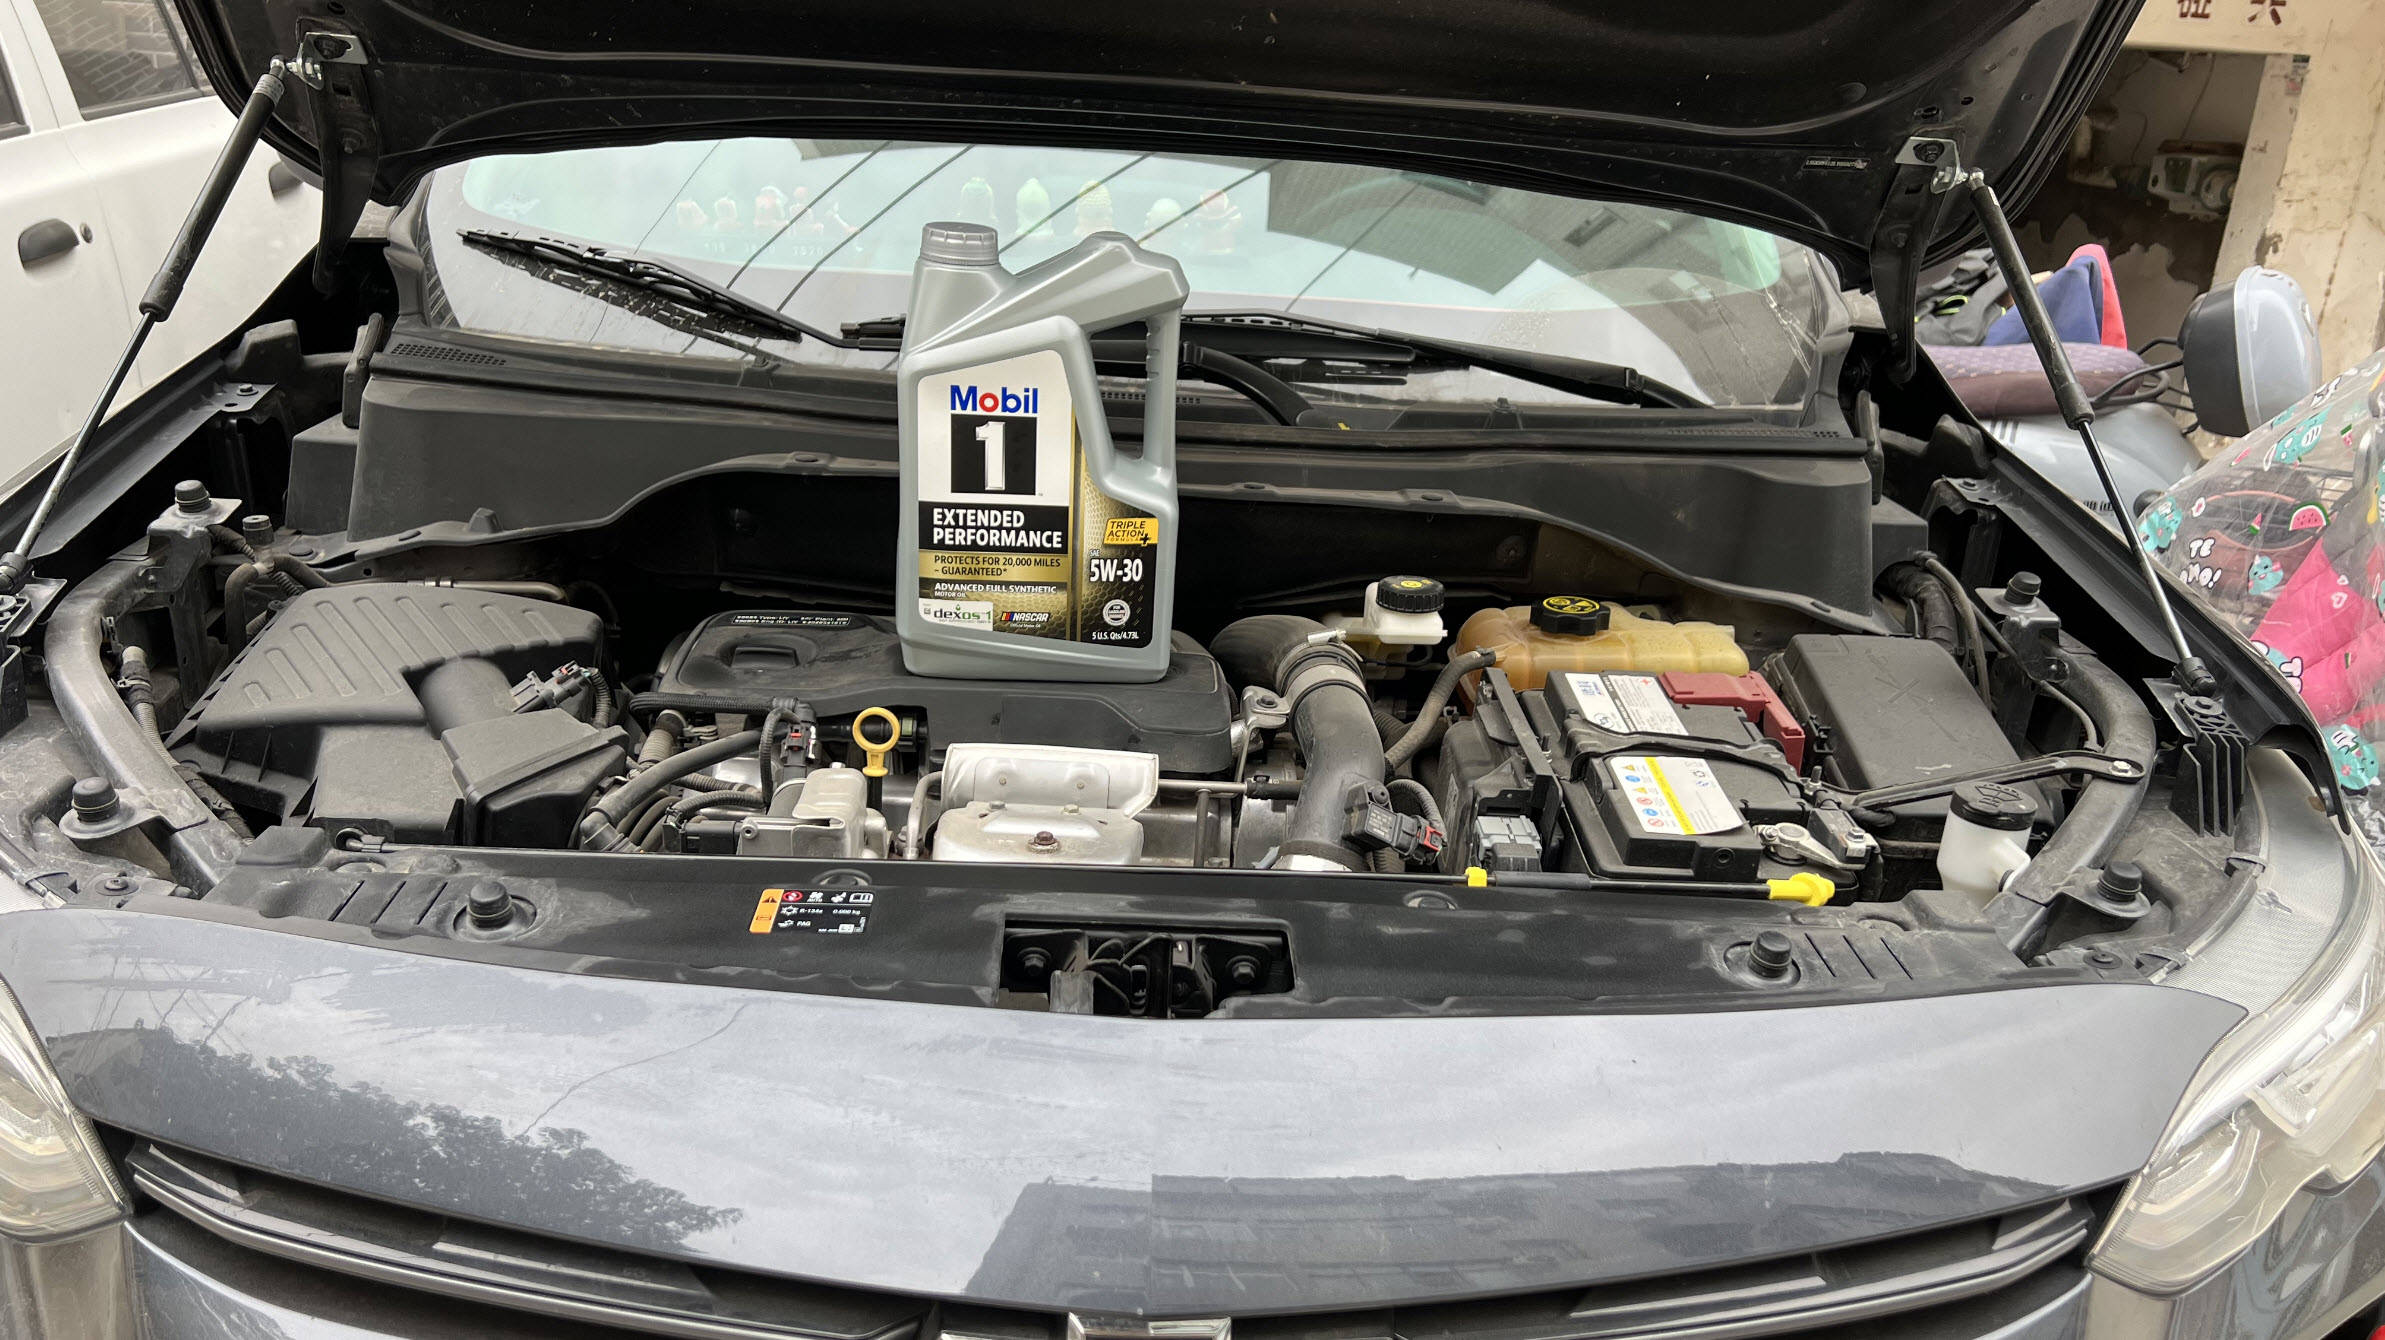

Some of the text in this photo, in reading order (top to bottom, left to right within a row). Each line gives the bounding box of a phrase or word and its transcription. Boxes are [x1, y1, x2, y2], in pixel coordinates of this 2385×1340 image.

[950, 384, 1038, 414] Mobil
[975, 421, 1006, 491] 1
[933, 508, 1025, 527] EXTENDED
[1110, 520, 1146, 529] TRIPLE
[933, 527, 1062, 548] PERFORMANCE
[2189, 537, 2215, 559] TE
[934, 555, 1061, 568] PROTECTS FOR 20,000 MILES
[1090, 558, 1143, 582] 5W-30
[934, 582, 1057, 594] ADVANCED FULL SYNTHETIC
[934, 608, 981, 620] dexos
[1012, 612, 1049, 622] NASCAR
[1092, 631, 1097, 640] 5
[1097, 631, 1109, 640] U.S.
